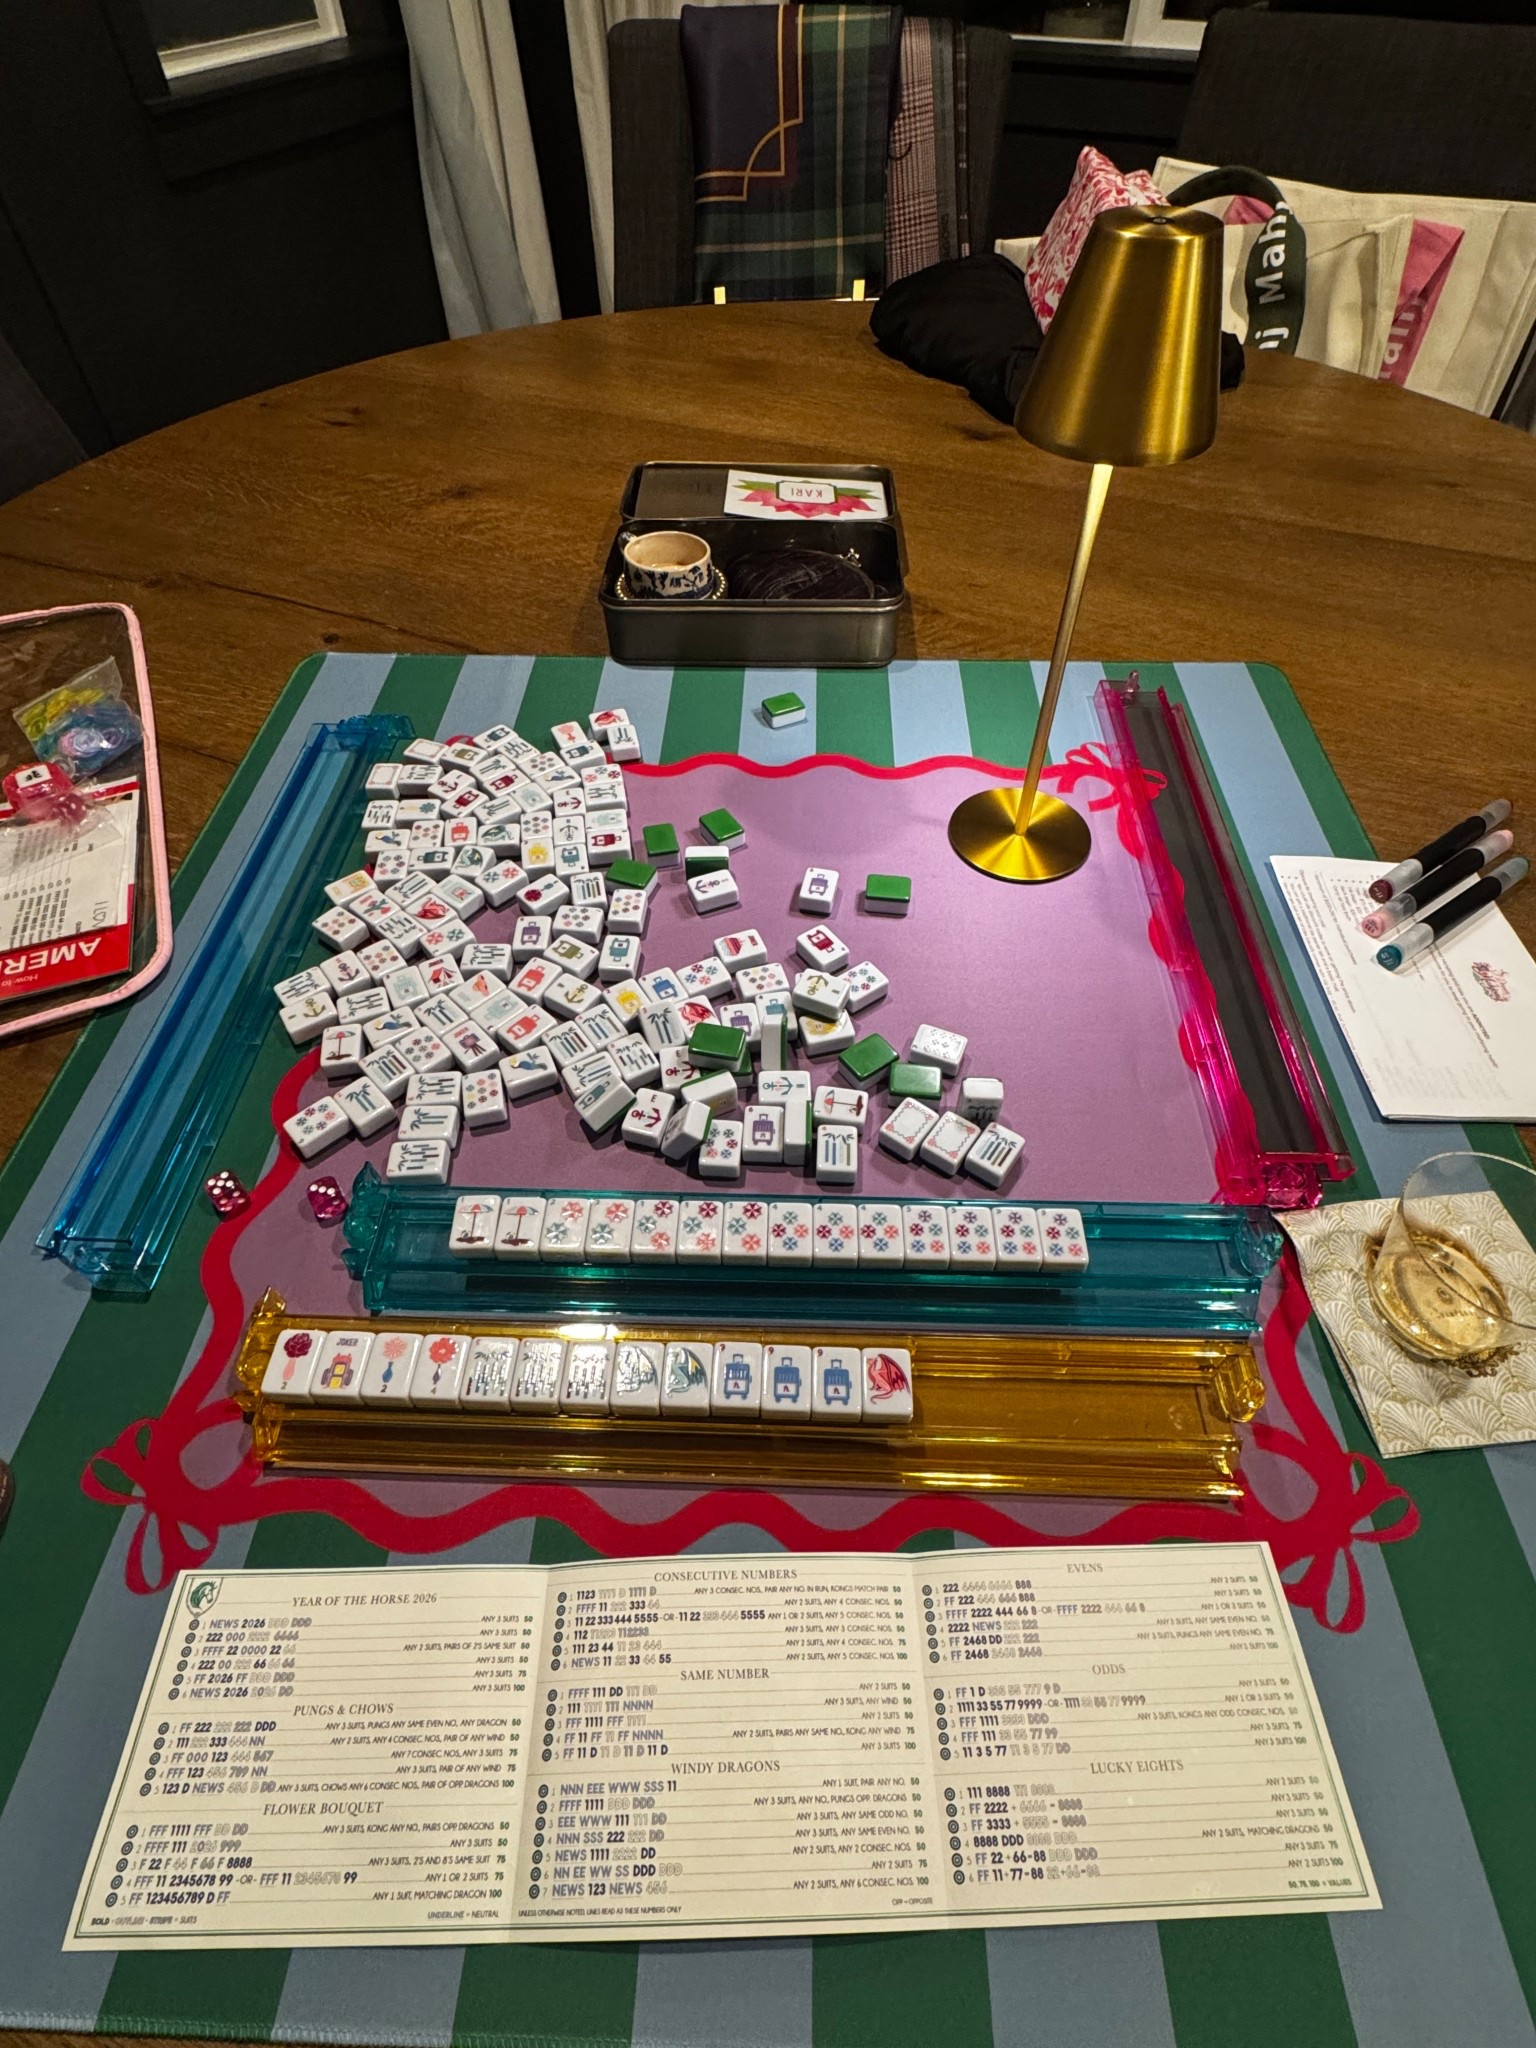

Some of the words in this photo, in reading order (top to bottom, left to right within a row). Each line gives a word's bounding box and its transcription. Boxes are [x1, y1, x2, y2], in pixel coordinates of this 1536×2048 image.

[791, 488, 823, 497] KARI
[15, 973, 39, 984] How
[336, 1338, 358, 1346] JOKER
[1067, 1563, 1103, 1573] EVENS
[654, 1571, 738, 1582] CONSECUTIVE
[742, 1570, 797, 1579] NUMBERS
[294, 1597, 322, 1606] YEAR
[325, 1596, 340, 1606] OF
[344, 1596, 366, 1605] THE
[371, 1594, 409, 1604] HORSE
[413, 1594, 436, 1603] 2026
[577, 1590, 595, 1600] 1123
[576, 1603, 596, 1614] FFFF
[599, 1602, 607, 1612] 11
[630, 1600, 645, 1610] 333
[946, 1609, 967, 1619] FFFF
[971, 1608, 992, 1618] 2222
[996, 1607, 1013, 1616] 444
[1016, 1606, 1028, 1616] 66
[210, 1619, 239, 1628] NEWS
[241, 1619, 265, 1628] 2026
[575, 1617, 583, 1626] 11
[585, 1616, 596, 1626] 22
[598, 1615, 613, 1625] 333
[614, 1614, 632, 1624] 444
[634, 1613, 658, 1623] 5555
[679, 1612, 687, 1621] 11
[690, 1612, 700, 1621] 22
[741, 1610, 765, 1620] 5555
[206, 1633, 223, 1642] 222
[226, 1632, 245, 1642] 000
[949, 1636, 960, 1646] FF
[964, 1635, 987, 1646] 2468
[989, 1635, 1002, 1644] DD
[202, 1646, 224, 1656] FFFF
[226, 1646, 238, 1655] 22
[241, 1645, 267, 1655] 0000
[270, 1645, 281, 1655] 22
[572, 1657, 600, 1668] NEWS
[603, 1656, 611, 1666] 11
[629, 1655, 640, 1665] 33
[659, 1654, 671, 1664] 55
[681, 1670, 713, 1680] SAME
[718, 1668, 769, 1679] NUMBER
[1092, 1664, 1126, 1675] ODDS
[194, 1674, 206, 1684] FF
[208, 1673, 233, 1684] 2026
[236, 1673, 248, 1683] FF
[190, 1688, 221, 1698] NEWS
[223, 1687, 248, 1697] 2026
[568, 1688, 590, 1699] FFFF
[593, 1687, 605, 1697] 111
[610, 1686, 623, 1697] DD
[294, 1705, 334, 1716] PUNGS
[337, 1705, 344, 1714] &
[349, 1703, 393, 1714] CHOWS
[957, 1702, 974, 1712] 1111
[977, 1701, 988, 1711] 33
[990, 1700, 1003, 1711] 55
[1004, 1700, 1015, 1710] 77
[1018, 1699, 1042, 1710] 9999
[180, 1722, 192, 1733] FF
[194, 1722, 212, 1733] 222
[255, 1721, 276, 1732] DDD
[368, 1721, 390, 1729] PUNGS
[407, 1720, 424, 1728] SAME
[426, 1720, 443, 1728] EVEN
[171, 1752, 184, 1763] FF
[186, 1752, 208, 1763] 000
[212, 1752, 228, 1762] 123
[166, 1768, 185, 1779] FFF
[188, 1767, 204, 1778] 123
[251, 1766, 268, 1777] NN
[672, 1762, 713, 1774] WINDY
[718, 1761, 780, 1773] DRAGONS
[1090, 1762, 1132, 1774] LUCKY
[1137, 1760, 1184, 1772] EIGHTS
[560, 1784, 584, 1795] NNN
[587, 1783, 605, 1794] EEE
[608, 1782, 640, 1793] WWW
[644, 1781, 664, 1792] SSS
[668, 1780, 676, 1792] 11
[967, 1787, 982, 1798] 111
[986, 1786, 1010, 1797] 8888
[263, 1803, 316, 1815] FLOWER
[320, 1802, 384, 1816] BOUQUET
[969, 1803, 980, 1814] FF
[984, 1802, 1008, 1814] 2222
[149, 1825, 168, 1836] FFF
[171, 1824, 191, 1836] 1111
[193, 1824, 213, 1836] FFF
[974, 1836, 998, 1848] 8888
[1002, 1834, 1024, 1846] DDD
[1247, 1826, 1284, 1836] MATCHING
[1285, 1825, 1320, 1834] DRAGONS
[1323, 1824, 1333, 1832] 50
[144, 1841, 170, 1853] FFFF
[172, 1841, 187, 1853] 111
[555, 1849, 586, 1862] NEWS
[590, 1848, 609, 1860] 1111
[641, 1847, 656, 1859] DD
[148, 1858, 162, 1870] 22
[227, 1857, 252, 1868] 8888
[554, 1867, 570, 1879] NN
[573, 1866, 586, 1878] EE
[590, 1866, 612, 1878] WW
[615, 1865, 629, 1877] SS
[633, 1864, 656, 1876] DDD
[134, 1876, 154, 1888] FFF
[156, 1875, 166, 1887] 11
[169, 1874, 216, 1886] 2345678
[220, 1874, 233, 1886] 99
[260, 1873, 279, 1885] FFF
[282, 1873, 292, 1885] 11
[344, 1872, 357, 1884] 99
[552, 1884, 584, 1896] NEWS
[588, 1883, 605, 1895] 123
[610, 1882, 642, 1895] NEWS
[129, 1892, 143, 1905] FF
[146, 1892, 204, 1904] 123456789
[216, 1891, 231, 1903] FF
[373, 1892, 388, 1900] ANY
[414, 1890, 452, 1900] MATCHING
[454, 1890, 486, 1899] DRAGON
[490, 1889, 502, 1898] 100
[428, 1911, 464, 1919] UNDERLINE
[472, 1910, 498, 1918] NEUTRAL
